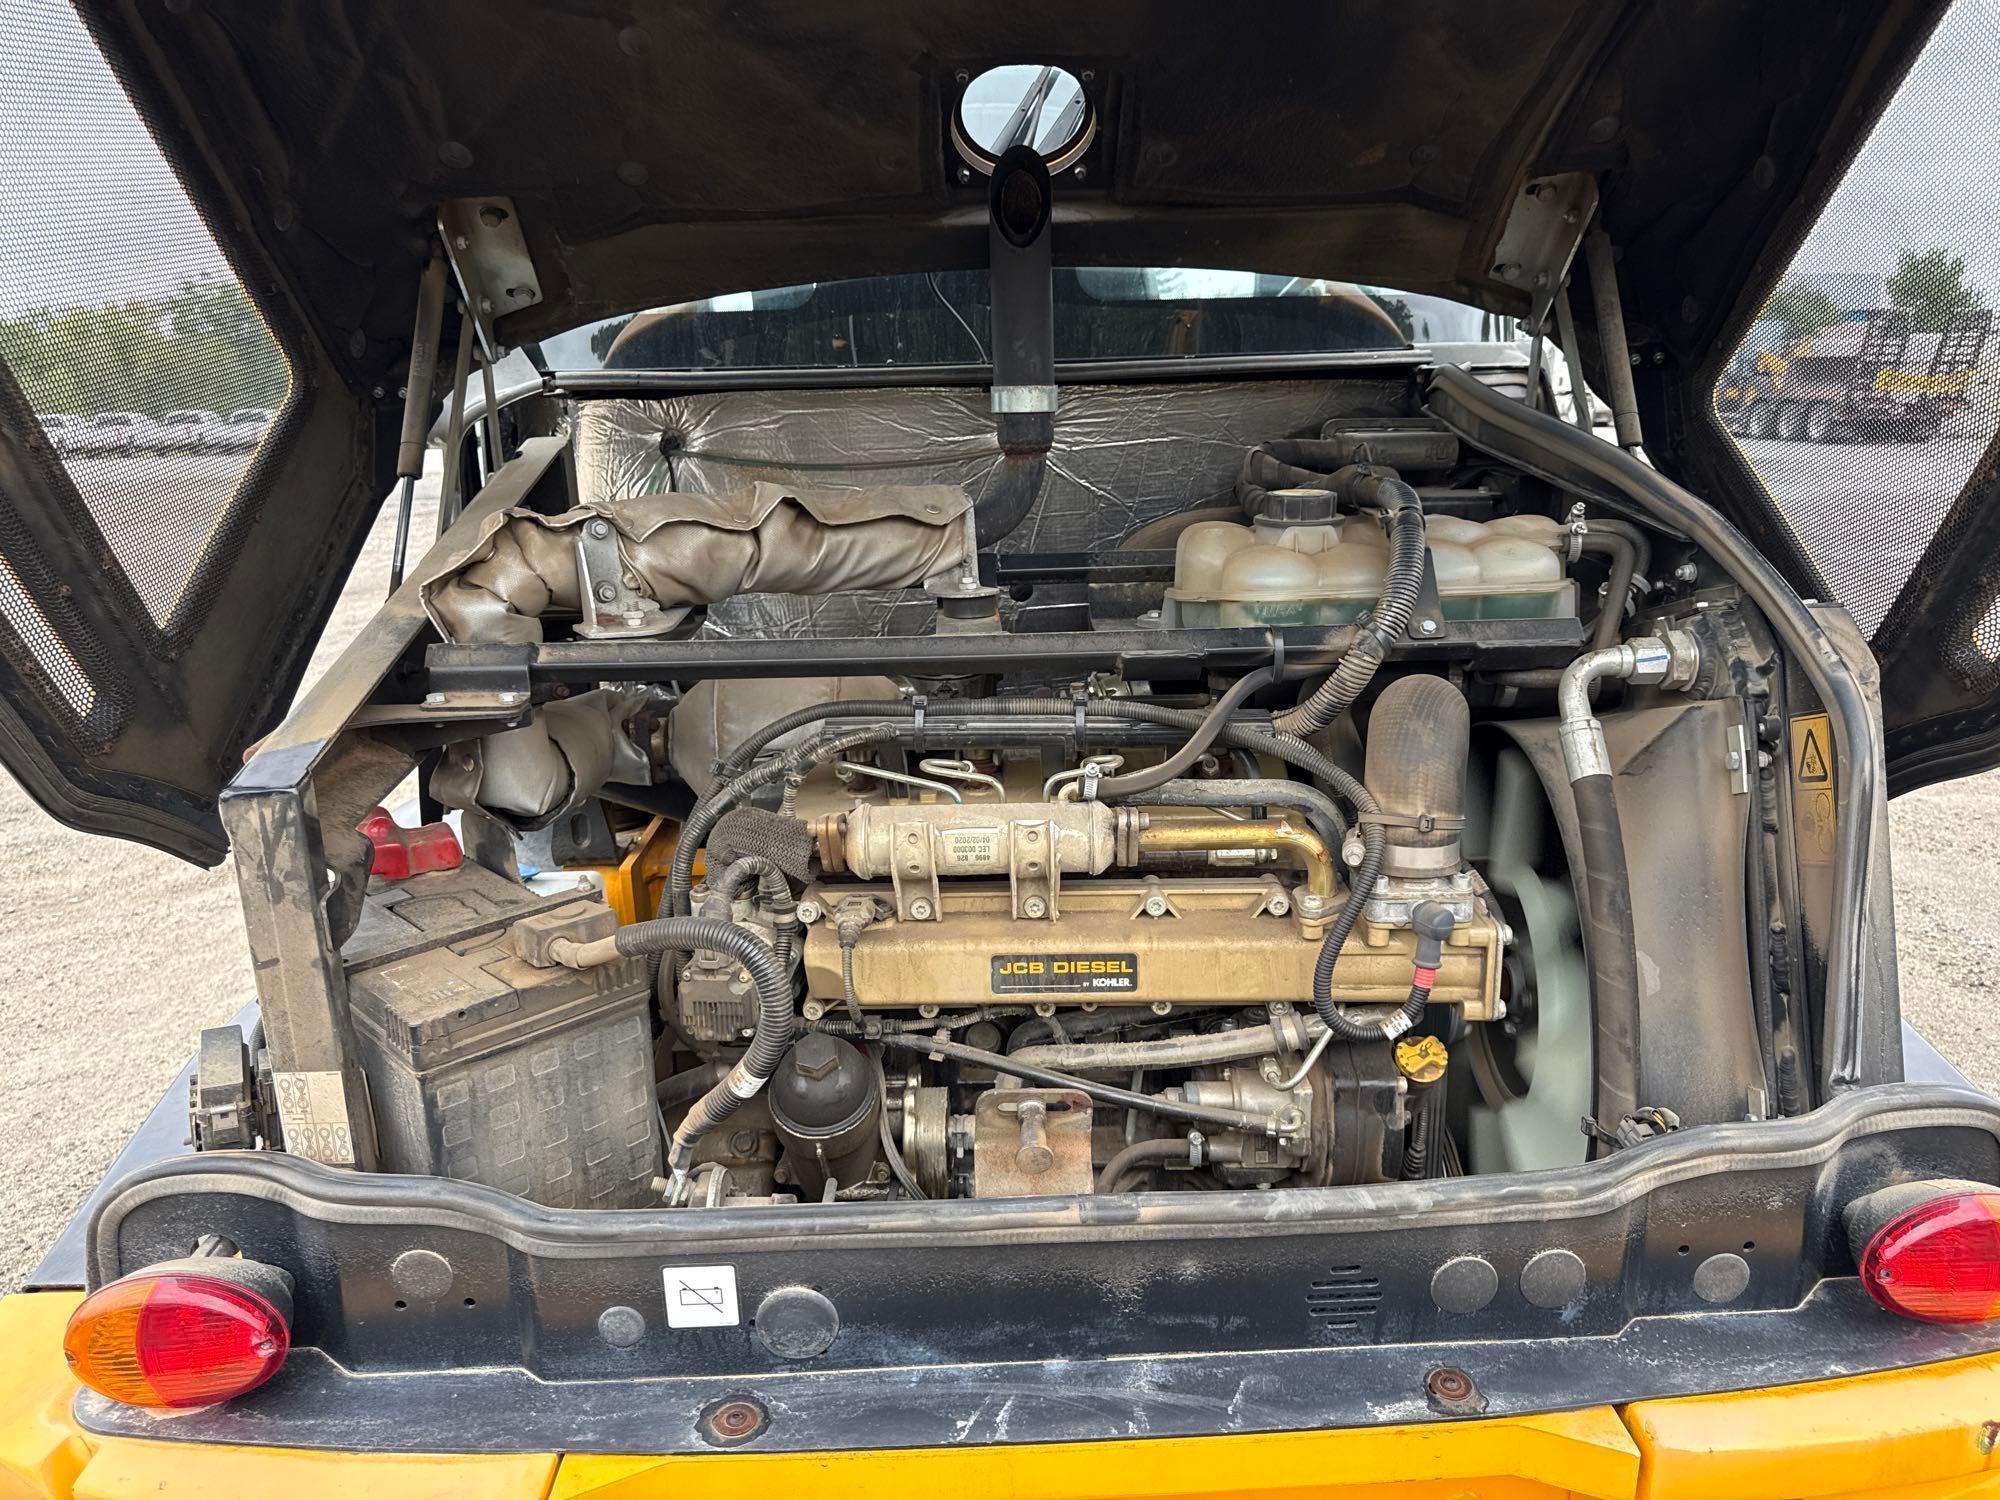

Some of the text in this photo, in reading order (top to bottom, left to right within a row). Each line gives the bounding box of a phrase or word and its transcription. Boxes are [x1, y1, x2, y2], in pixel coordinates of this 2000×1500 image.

[954, 836, 990, 844] 04/02/2020
[978, 845, 990, 853] LEC
[999, 961, 1133, 974] JCB DIESEL
